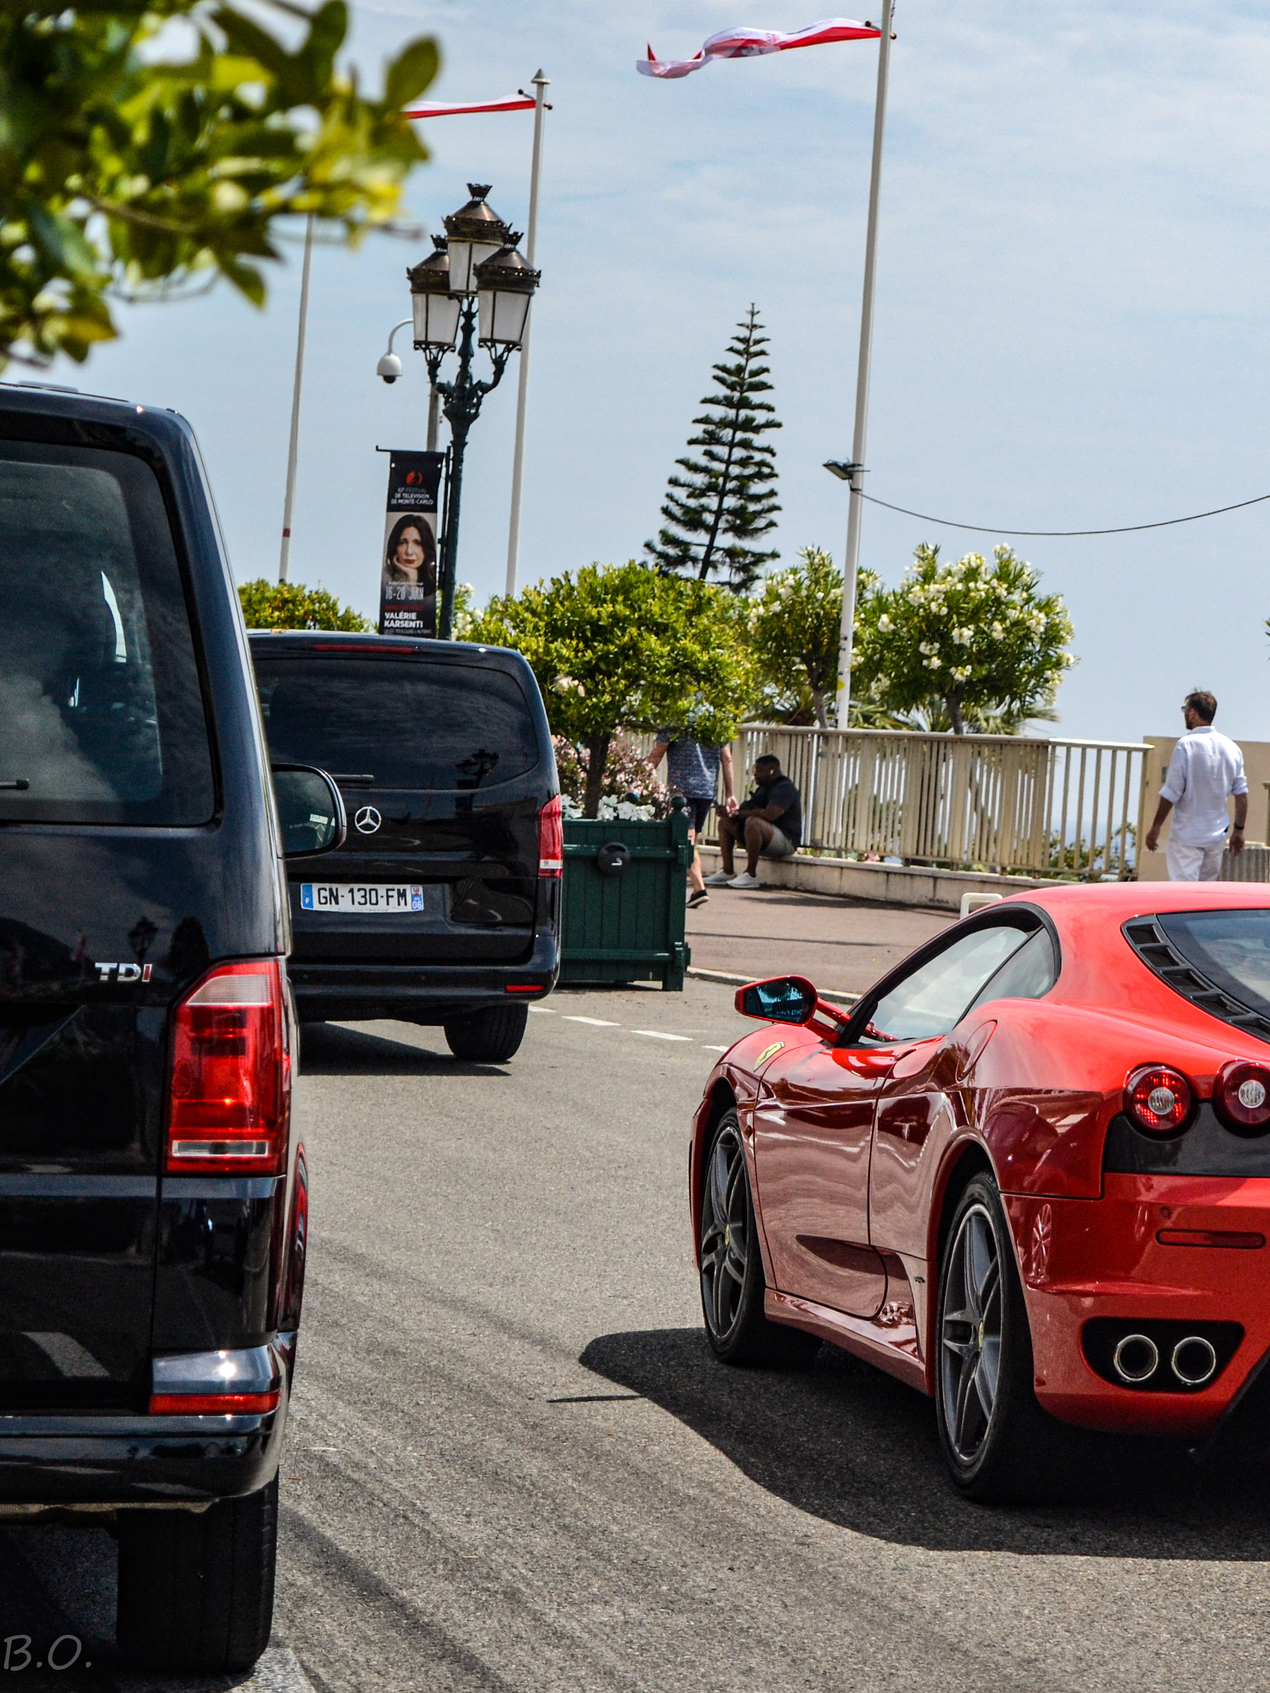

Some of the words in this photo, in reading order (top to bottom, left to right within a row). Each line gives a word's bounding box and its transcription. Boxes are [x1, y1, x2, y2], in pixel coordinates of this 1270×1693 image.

[384, 611, 417, 620] VALÉRIE
[384, 620, 423, 628] KARSENTI
[317, 887, 408, 907] GN-130-FM
[411, 900, 422, 909] 06
[94, 962, 153, 982] TDI
